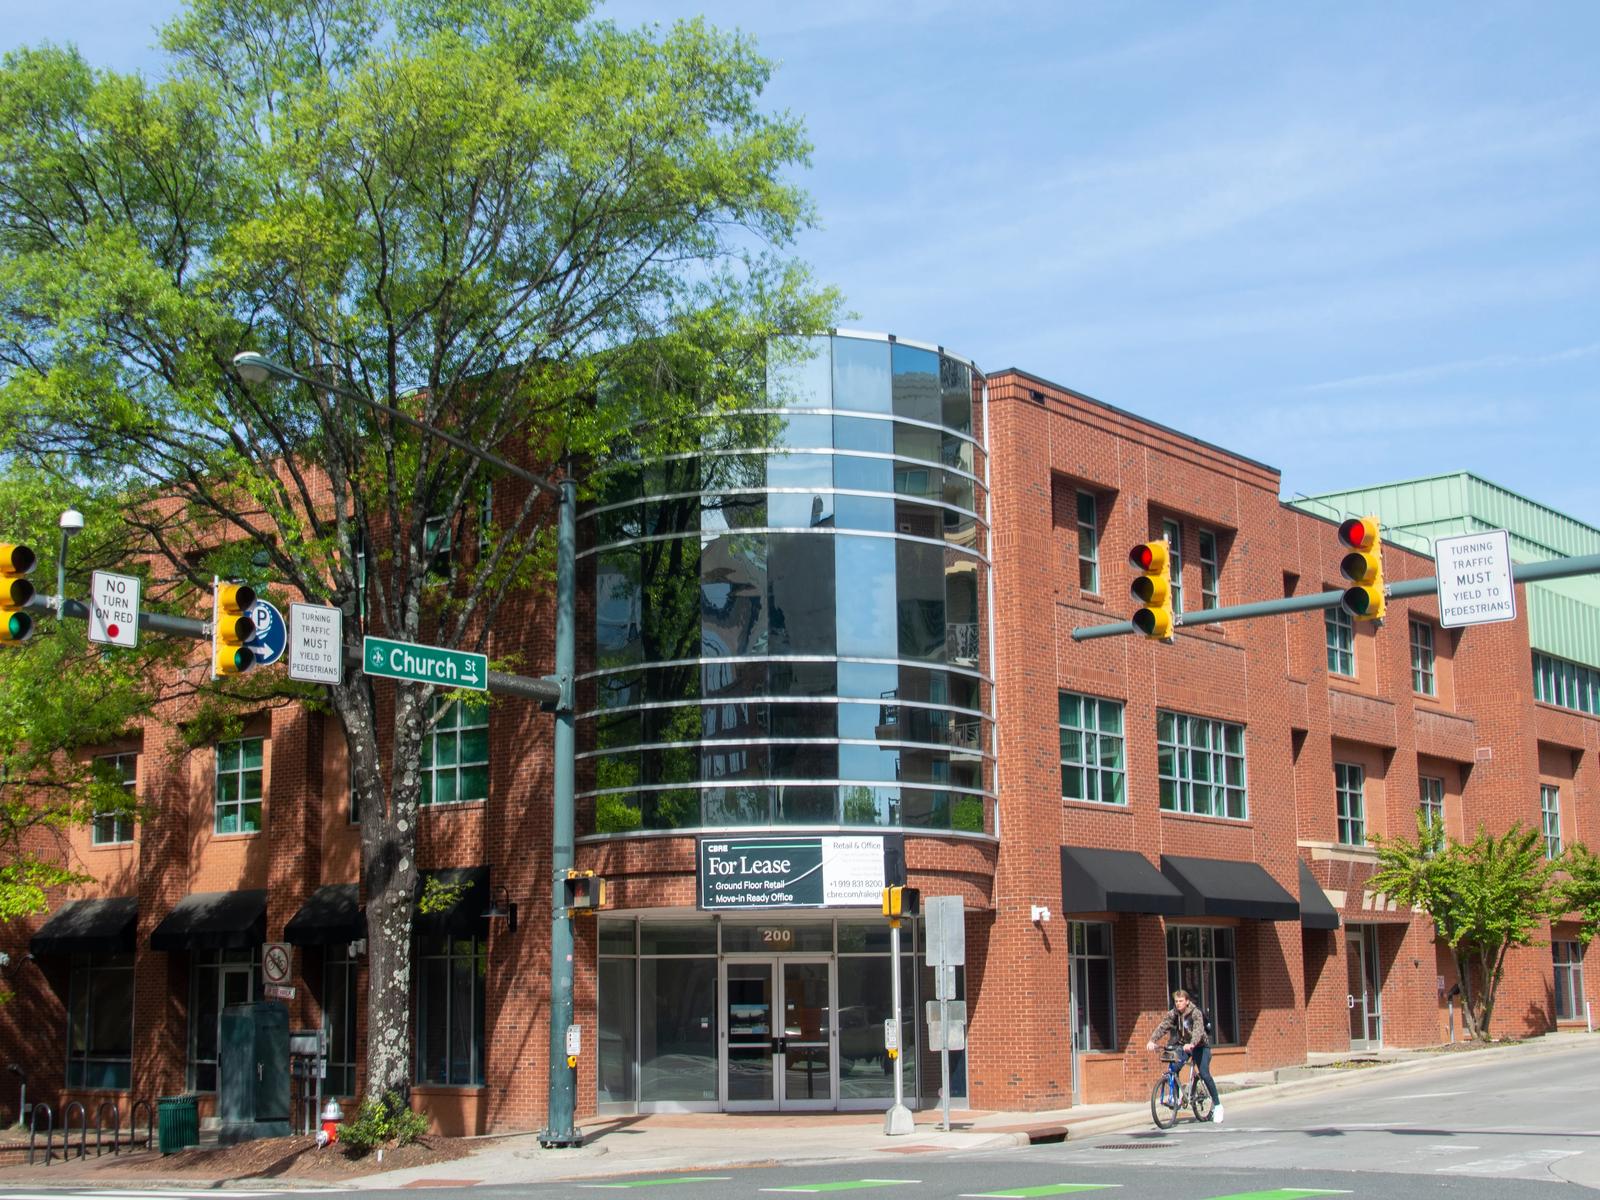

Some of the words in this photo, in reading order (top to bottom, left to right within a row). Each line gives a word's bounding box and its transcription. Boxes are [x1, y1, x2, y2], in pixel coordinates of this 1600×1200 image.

[1451, 542, 1493, 555] TURNING
[1453, 556, 1494, 570] TRAFFIC
[1456, 571, 1491, 586] MUST
[106, 579, 126, 594] NO
[1453, 590, 1482, 601] YIELD
[1487, 587, 1500, 597] TO
[103, 595, 129, 609] TURN
[1444, 601, 1510, 617] PEDESTRIANS
[95, 608, 110, 620] ON
[114, 611, 133, 624] RED
[257, 609, 267, 627] P
[301, 612, 331, 624] TURNING
[302, 625, 331, 635] TRAFFIC
[303, 637, 328, 649] MUST
[299, 651, 320, 661] YIELD
[323, 654, 332, 663] TO
[292, 663, 338, 676] PEDESTRIANS
[389, 648, 457, 680] Church
[465, 659, 476, 672] St
[707, 844, 728, 853] CBRE
[833, 841, 853, 850] Retail
[861, 841, 881, 850] Office
[708, 857, 738, 876] For
[740, 856, 791, 874] Lease
[715, 881, 742, 890] Ground
[743, 880, 762, 890] Floor
[763, 880, 785, 889] Retail
[837, 880, 850, 888] 919
[851, 880, 864, 888] 831
[864, 880, 883, 888] 8200
[715, 894, 745, 903] Move-in
[746, 893, 769, 904] Ready
[771, 892, 794, 902] Office
[764, 930, 790, 941] 200
